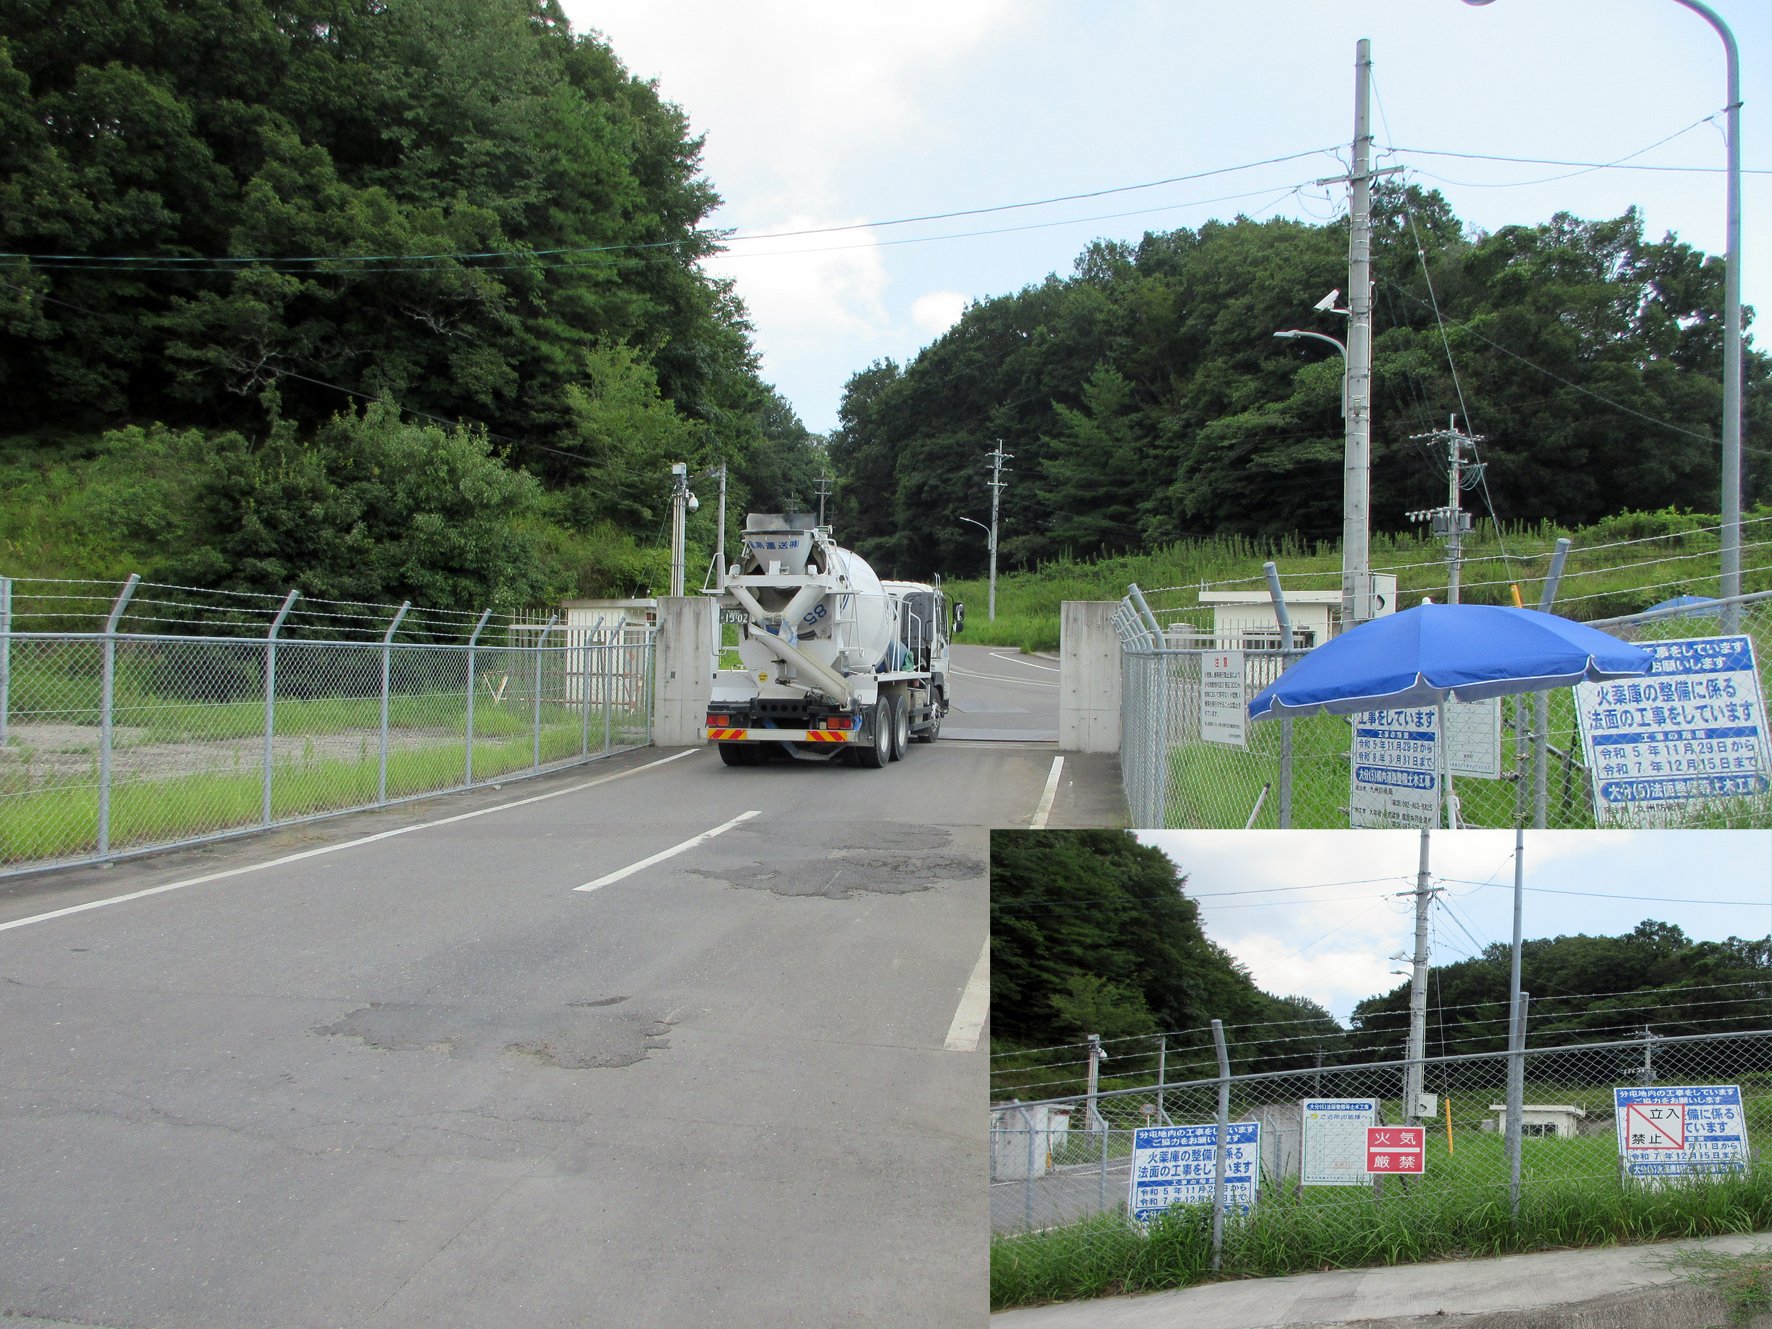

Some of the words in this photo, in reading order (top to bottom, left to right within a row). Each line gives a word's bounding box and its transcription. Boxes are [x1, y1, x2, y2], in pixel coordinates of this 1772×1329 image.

[1597, 677, 1736, 706] 火薬庫の整備に係る
[1588, 700, 1753, 730] 法面の工事をしています
[1650, 1108, 1680, 1120] 立入
[1685, 1108, 1735, 1120] 備に係る
[1375, 1132, 1416, 1145] 火気
[1632, 1133, 1662, 1145] 禁止
[1373, 1155, 1416, 1169] 厳禁
